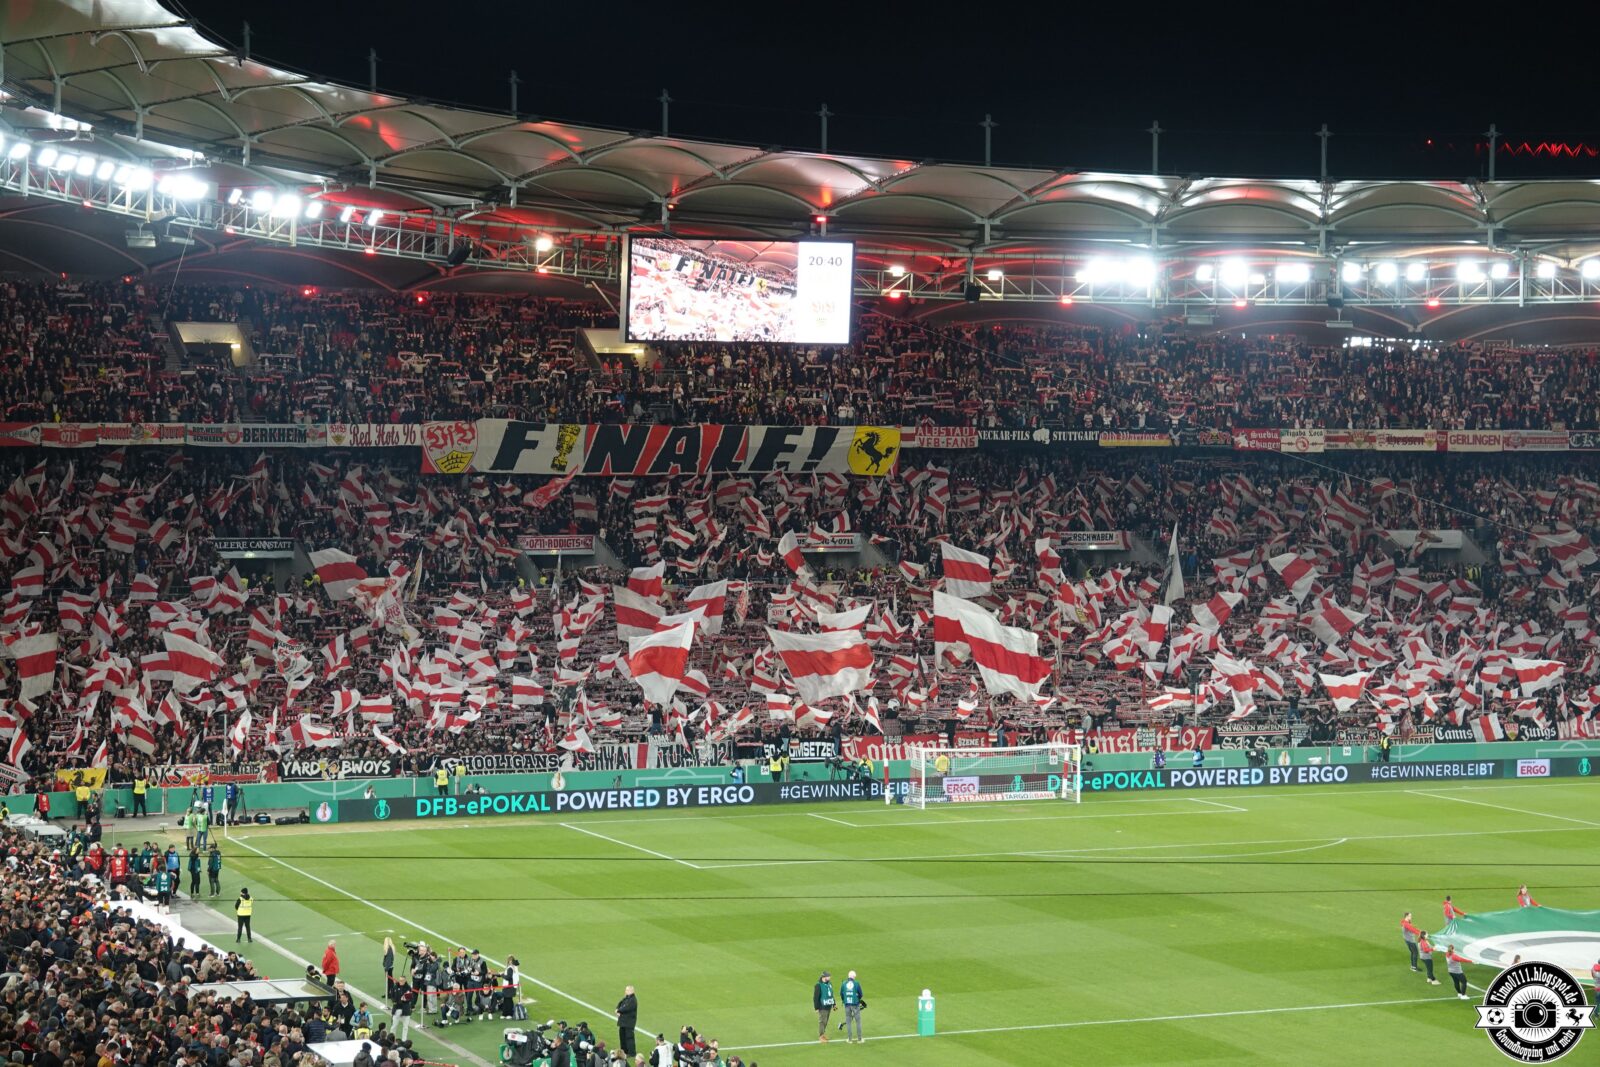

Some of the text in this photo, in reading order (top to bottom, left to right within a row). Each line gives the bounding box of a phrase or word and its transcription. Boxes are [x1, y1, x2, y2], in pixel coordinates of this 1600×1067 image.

[60, 431, 79, 443] 0711
[243, 427, 307, 443] BERKHEIM
[350, 422, 416, 445] Red Hots 96
[917, 427, 977, 437] ALBSTADT
[977, 430, 1099, 441] NECKAR-FILS STUTTGART
[918, 438, 976, 448] VFB-FANS
[1449, 434, 1500, 446] GERLINGEN
[249, 541, 291, 550] CANNSTATT
[529, 537, 581, 549] 0711 ADDICTS
[1182, 728, 1209, 751] 97
[1520, 724, 1557, 741] Jungs
[282, 759, 391, 777] YARD BWOYS
[461, 754, 559, 771] HOOLIGANS
[1170, 767, 1264, 787] POWERED
[1269, 767, 1293, 784] BY
[1297, 765, 1349, 783] ERGO
[1371, 762, 1496, 778] #GEWINNERBLEIBT
[1520, 765, 1547, 775] ERGO
[946, 783, 976, 794] ERGO
[416, 785, 755, 817] DFB-ePOKAL POWERED BY ERGO
